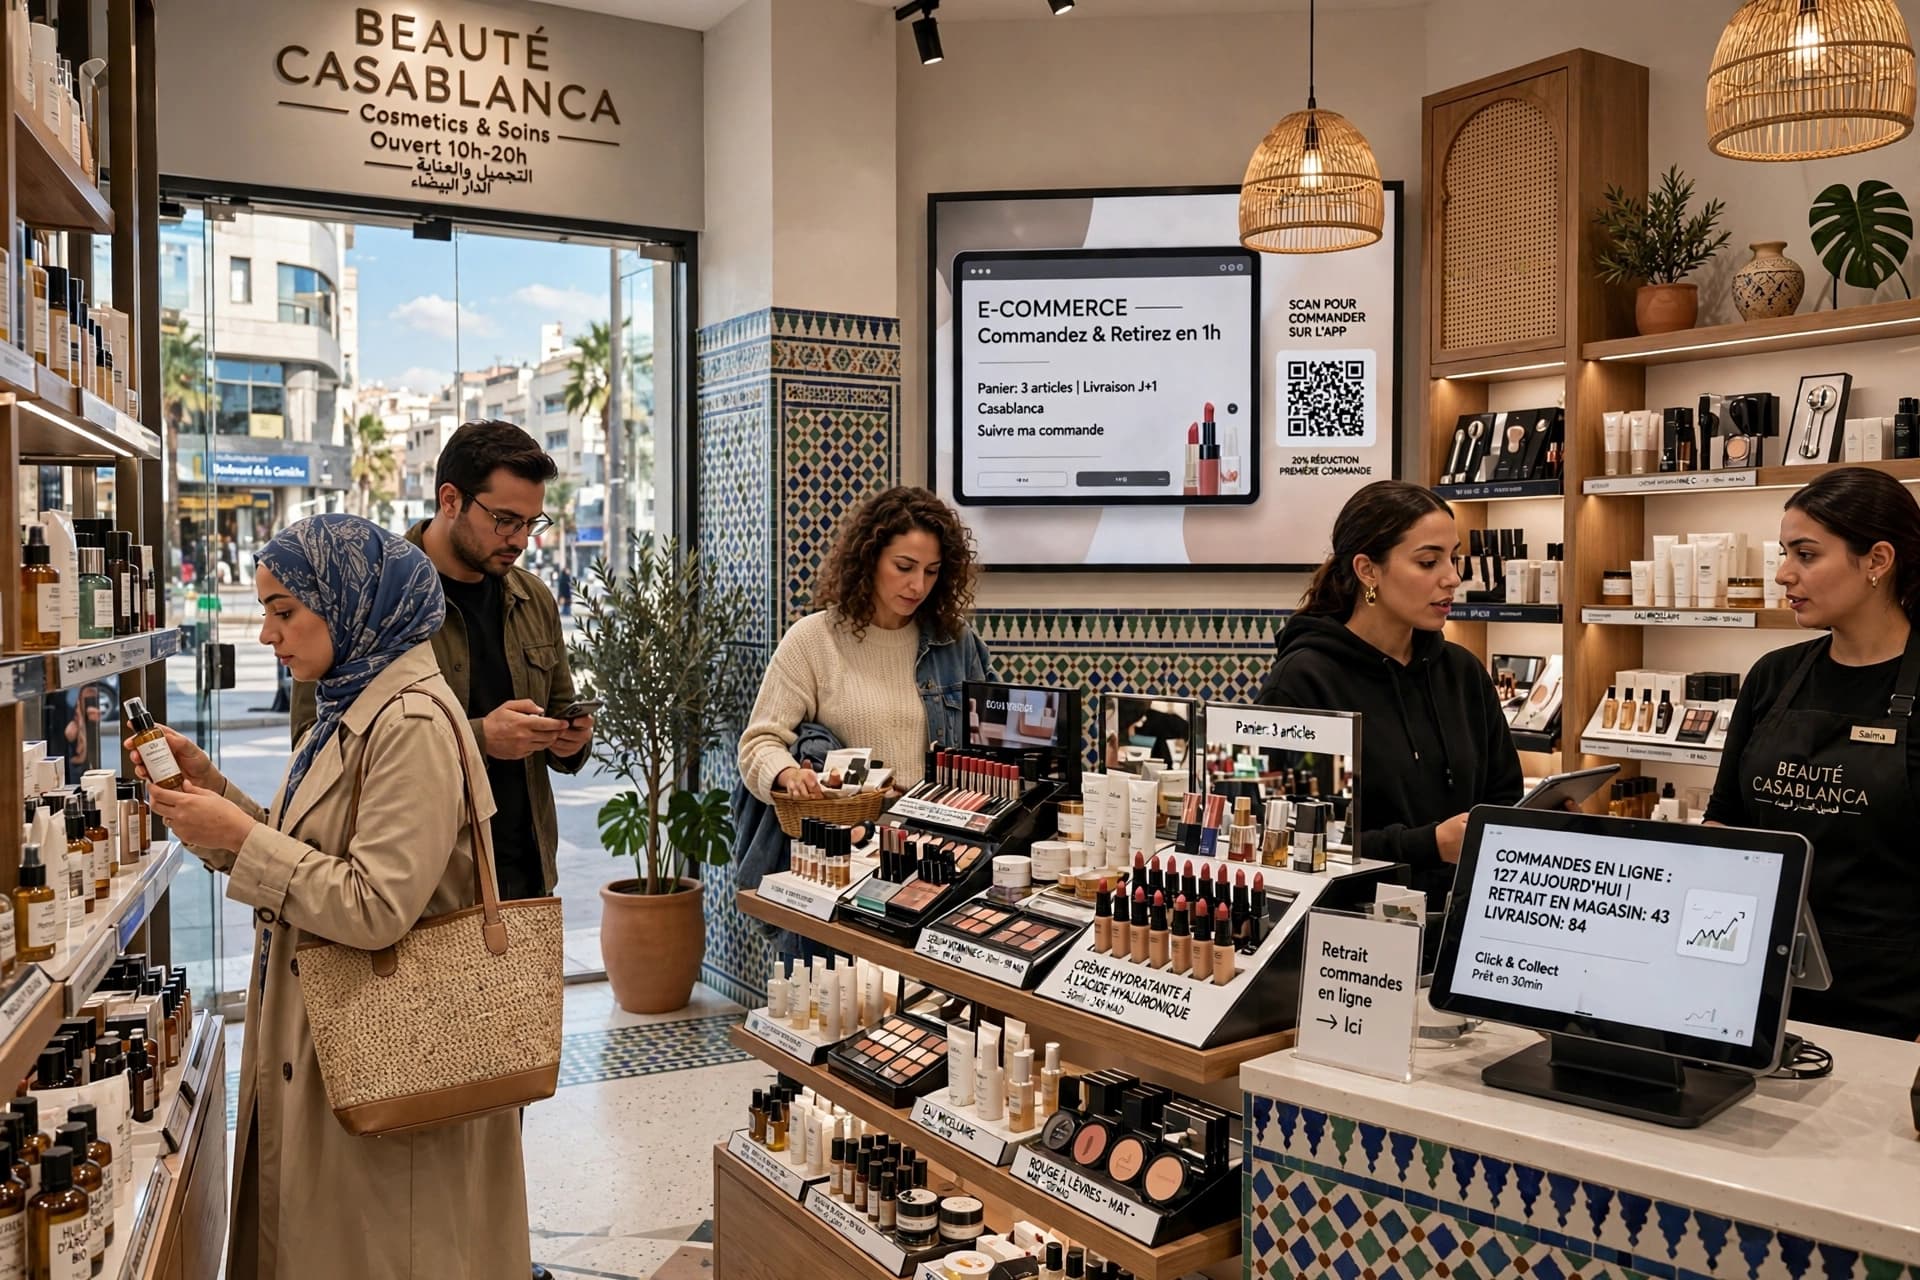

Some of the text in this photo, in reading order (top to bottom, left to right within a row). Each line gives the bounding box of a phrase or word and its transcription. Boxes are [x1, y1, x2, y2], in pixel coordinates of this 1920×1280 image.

[356, 8, 549, 71] BEAUTÉ
[276, 45, 621, 125] CASABLANCA
[360, 103, 550, 143] Cosmetics & Soins
[371, 131, 527, 165] Ouvert 10h-20h
[416, 157, 533, 184] التجميل والعناية
[411, 176, 491, 195] الدار البيضاء
[978, 299, 1128, 318] E-COMMERCE
[1288, 298, 1357, 310] SCAN POUR
[1288, 312, 1366, 324] COMMANDER
[978, 323, 1221, 344] Commandez & Retirez en 1h
[1288, 326, 1347, 337] SUR L'APP
[978, 382, 1018, 395] Panier:
[1021, 382, 1028, 394] 3
[1031, 381, 1073, 394] articles
[1083, 380, 1135, 393] Livraison
[1138, 380, 1157, 393] J+1
[978, 402, 1044, 415] Casablanca
[977, 424, 1104, 437] Suivre ma commande
[1311, 453, 1359, 464] RÉDUCTION
[1321, 466, 1372, 475] COMMANDE
[1272, 723, 1279, 737] 3
[1281, 725, 1316, 740] articles
[1776, 760, 1844, 784] BEAUTÉ
[1753, 776, 1869, 806] CASABLANCA
[1496, 848, 1592, 873] COMMANDES
[1594, 861, 1616, 876] EN
[1618, 863, 1665, 883] LIGNE
[1493, 867, 1518, 883] 127
[1520, 871, 1622, 898] AUJOURD'HUI
[1488, 886, 1670, 924] RETRAIT EN MAGASIN: 43
[1484, 905, 1587, 933] LIVRAISON: 84
[1322, 941, 1368, 963] Retrait
[1475, 951, 1559, 977] Click & Collect
[1074, 959, 1192, 1003] CRÈME HYDRATANTE À
[1320, 966, 1403, 992] commandes
[1472, 968, 1543, 991] Prêt en 30min
[1064, 969, 1191, 1020] À L'ACIDE HYALURONIQUE
[1318, 986, 1372, 1008] en ligne
[1344, 1016, 1362, 1035] Ici
[1029, 1157, 1060, 1180] ROUGE
[1060, 1169, 1068, 1185] À
[1108, 1197, 1131, 1216] MAT
